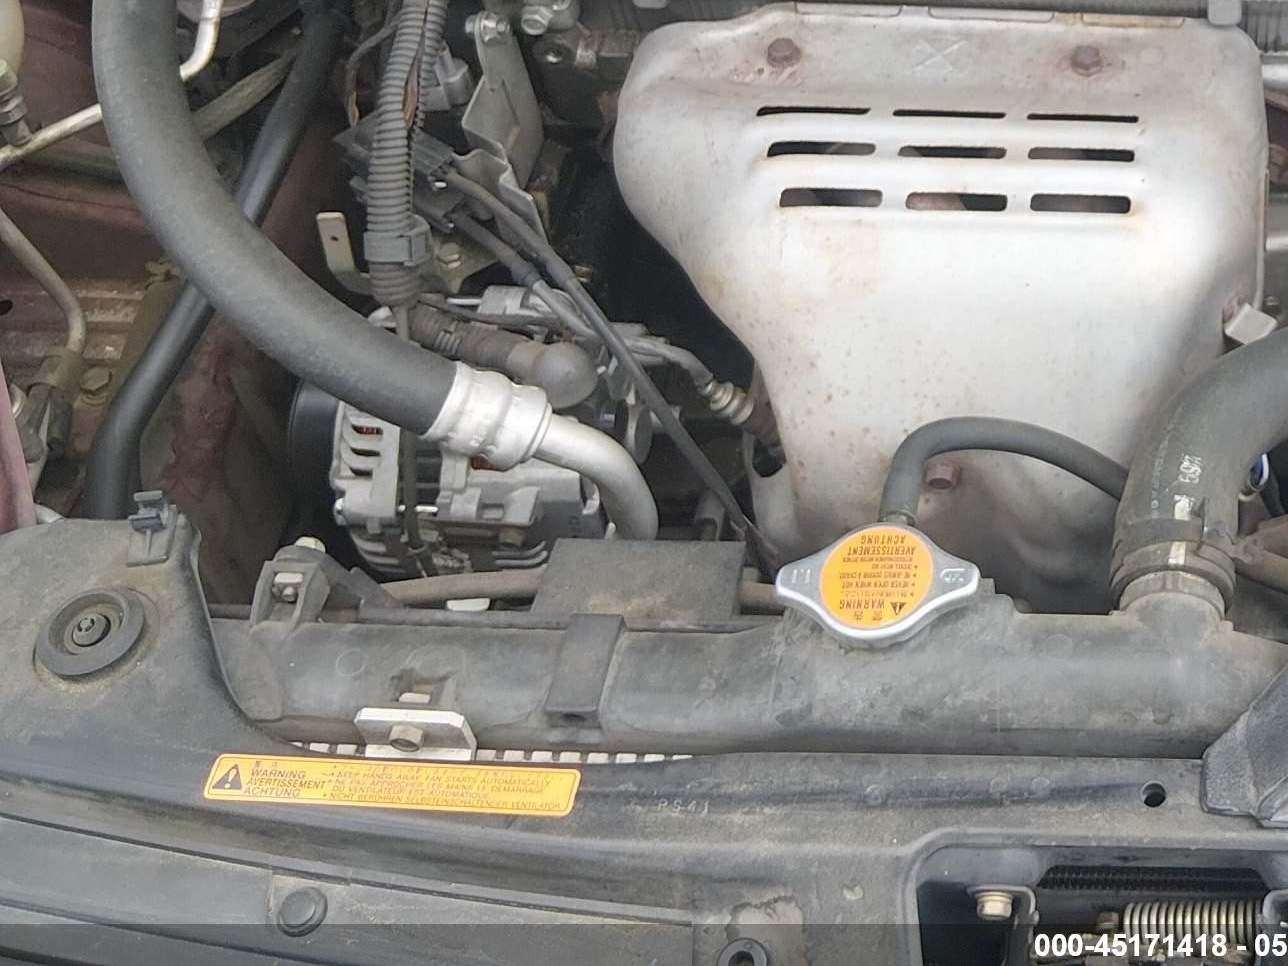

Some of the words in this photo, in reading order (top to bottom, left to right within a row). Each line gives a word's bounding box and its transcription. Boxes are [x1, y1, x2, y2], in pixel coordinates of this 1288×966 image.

[860, 535, 906, 545] ACHTUNG
[847, 545, 917, 556] AVERTISSEMENT
[791, 569, 811, 584] 1.1
[839, 598, 885, 610] WARNING
[252, 769, 305, 779] WARNING
[246, 777, 325, 789] AVERTISSEMENT
[480, 777, 552, 787] AUTOMATICALLY
[244, 786, 301, 797] ACHTUNG
